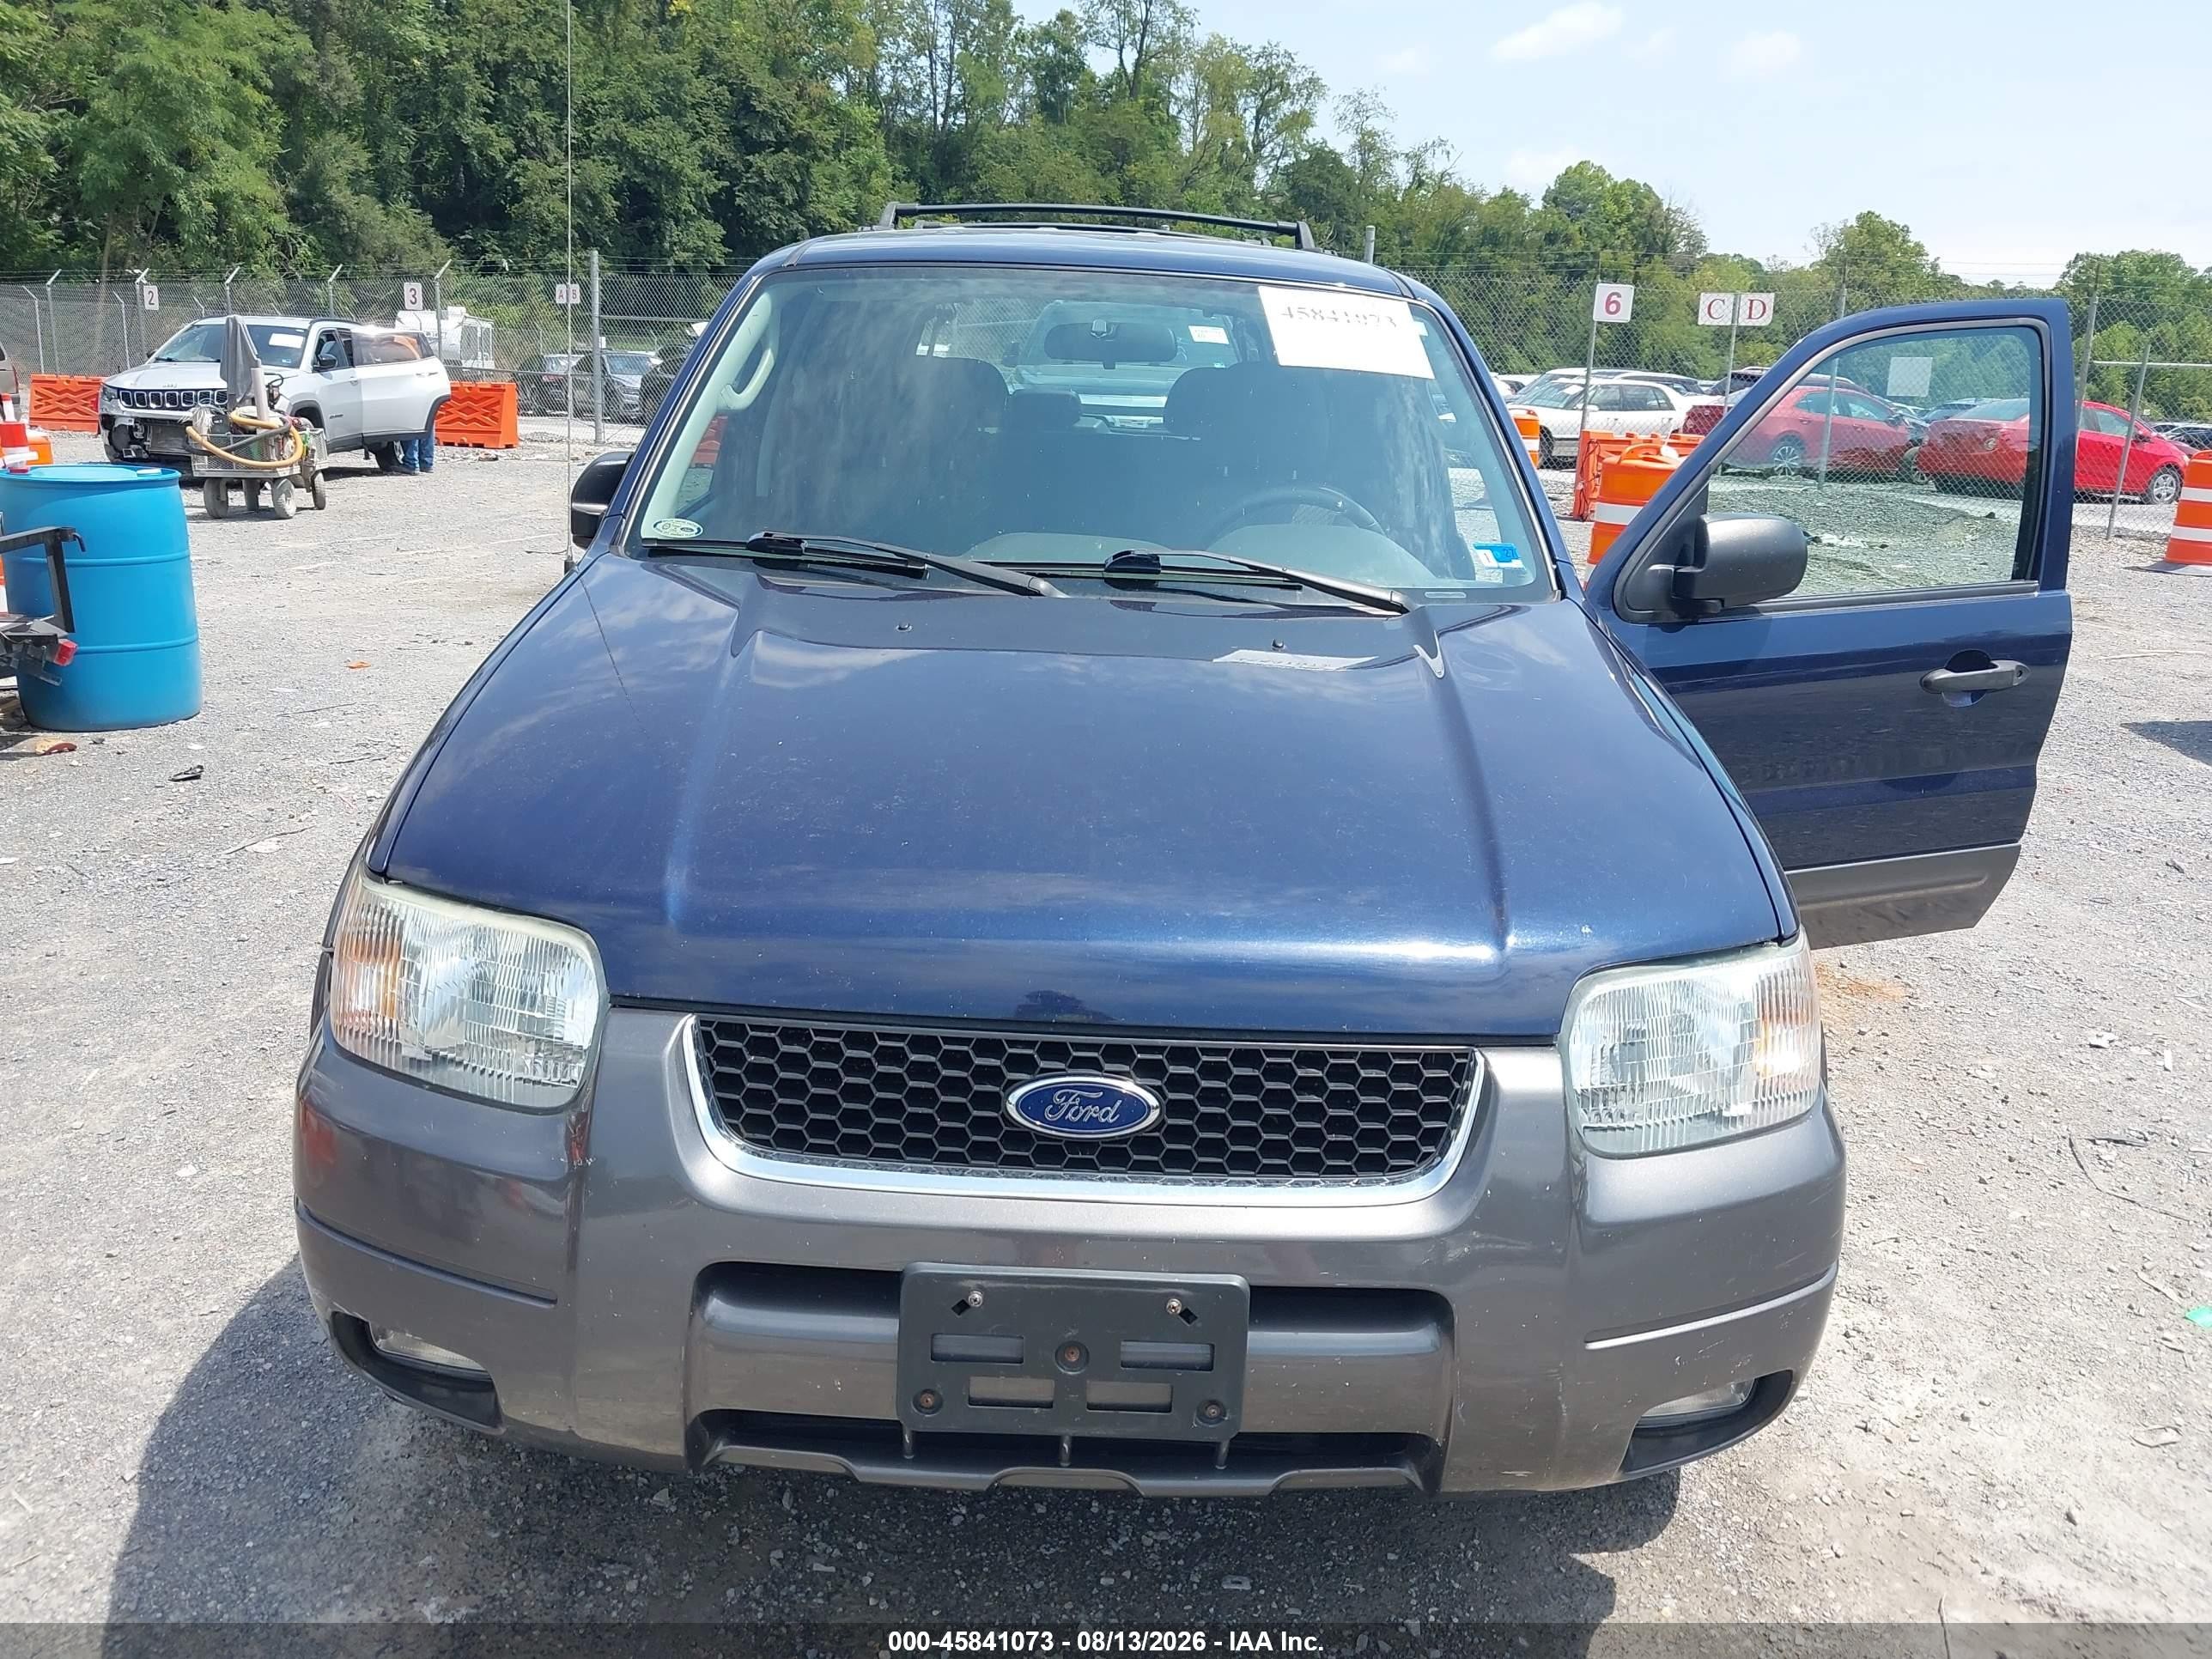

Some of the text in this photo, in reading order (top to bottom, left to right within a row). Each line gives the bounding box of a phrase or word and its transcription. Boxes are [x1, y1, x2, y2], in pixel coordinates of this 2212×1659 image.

[148, 290, 155, 306] 2
[409, 287, 417, 305] 3
[558, 289, 564, 300] A
[1604, 291, 1622, 316] 6
[1280, 306, 1398, 328] 45841073
[1706, 298, 1726, 320] C
[1747, 298, 1767, 320] D
[1044, 1089, 1122, 1123] Ford
